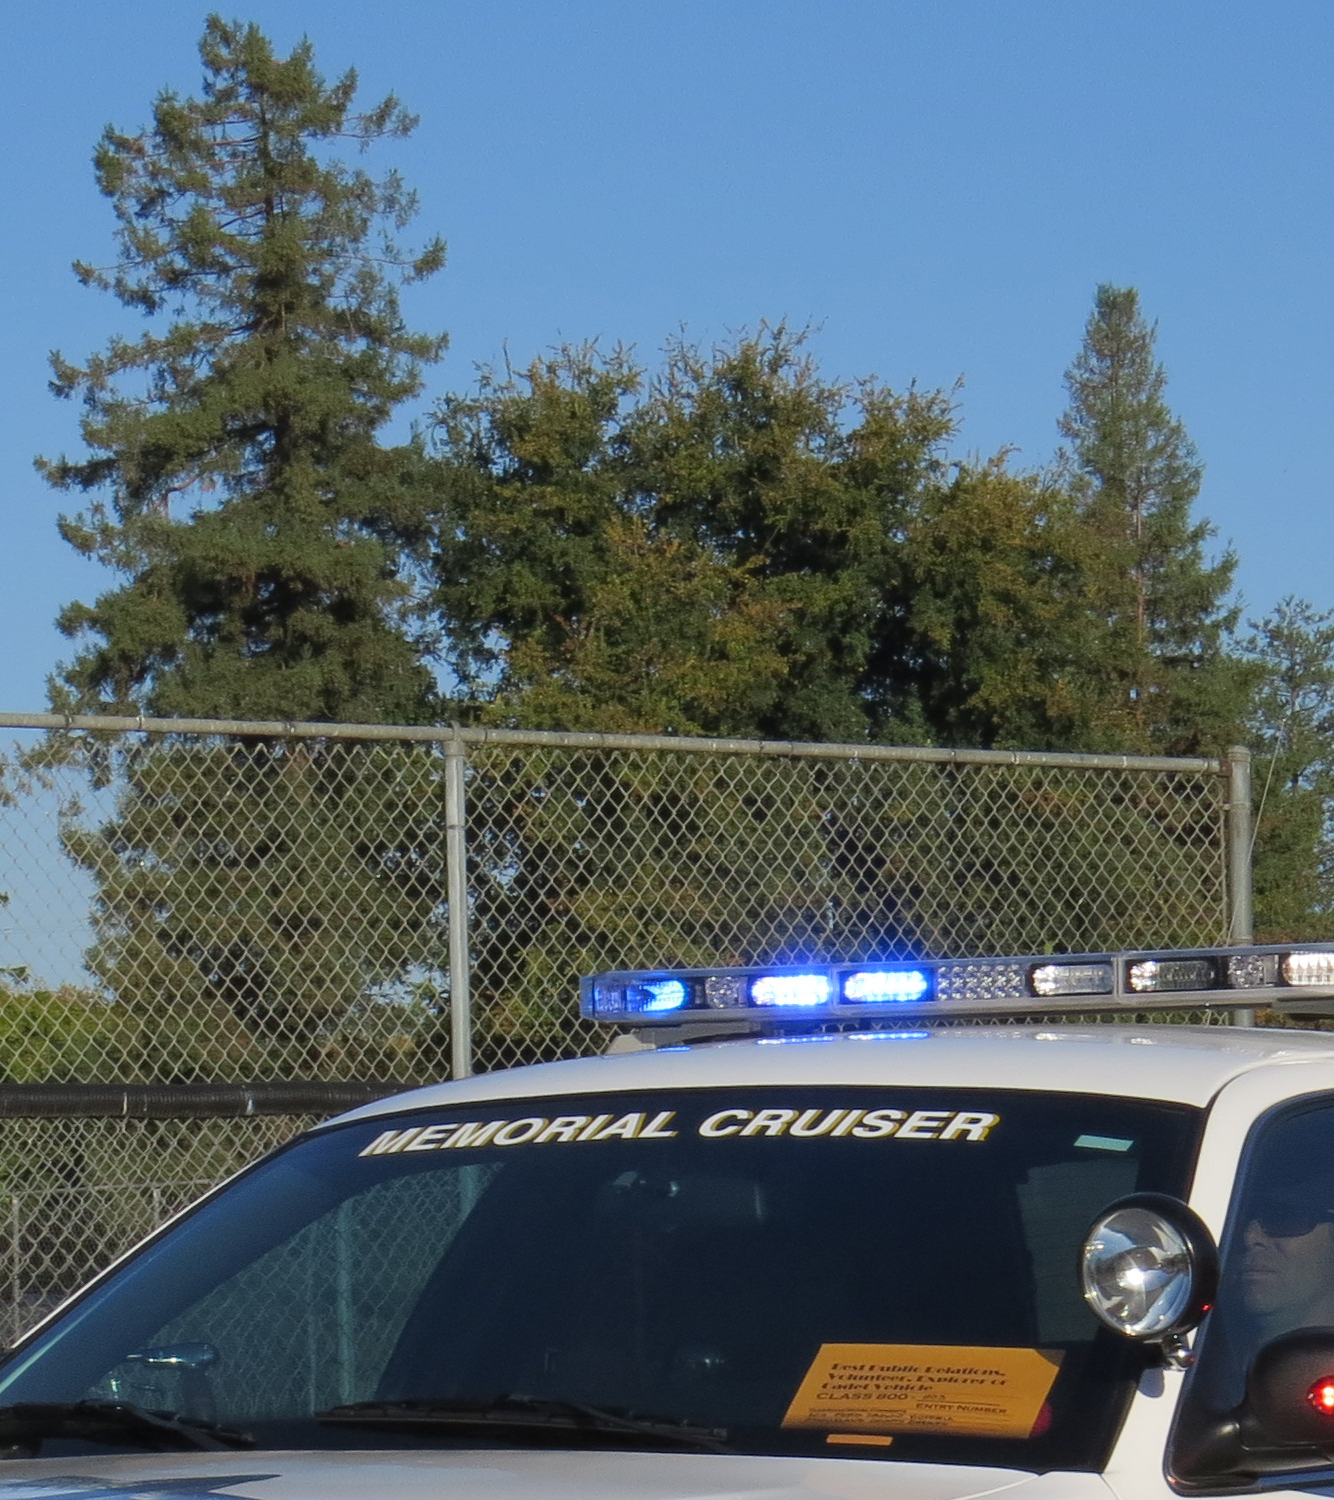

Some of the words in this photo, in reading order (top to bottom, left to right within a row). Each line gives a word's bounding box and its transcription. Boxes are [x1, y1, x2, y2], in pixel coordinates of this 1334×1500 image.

[357, 1110, 679, 1158] MEMORIAL
[698, 1108, 1001, 1142] CRUISER
[816, 1392, 873, 1400] CLASS
